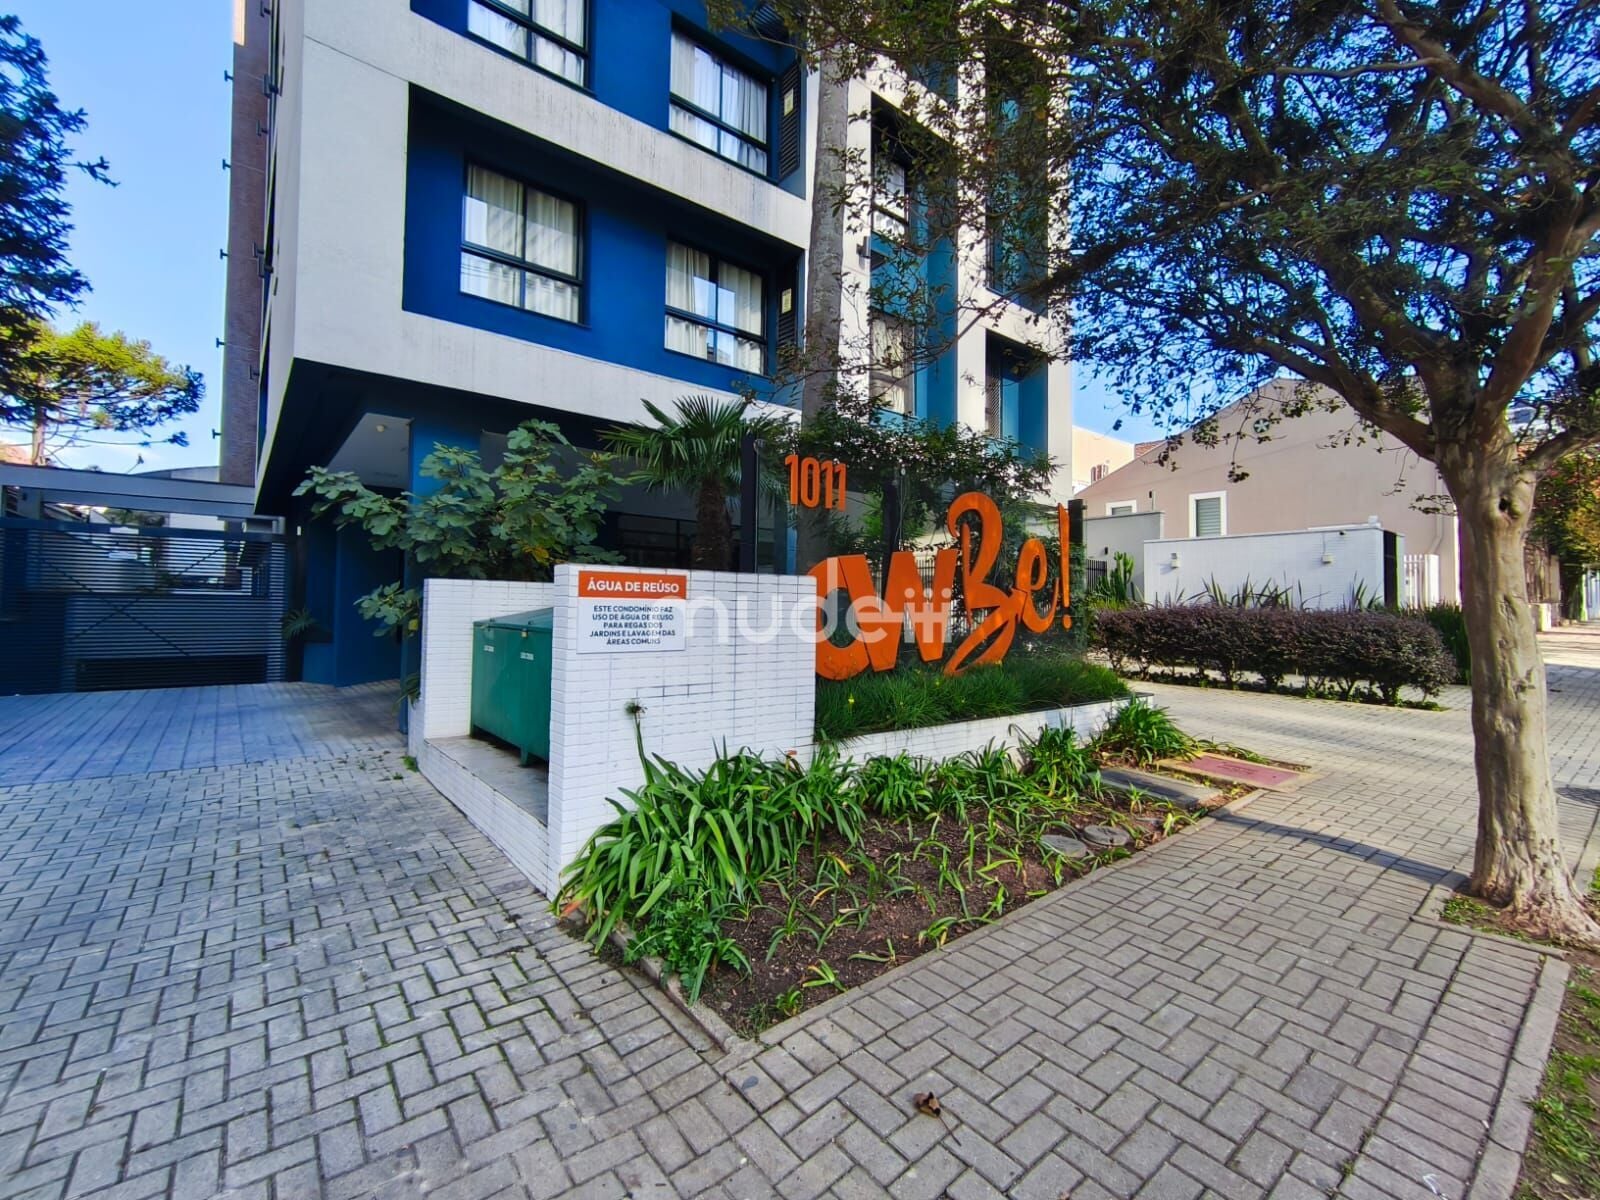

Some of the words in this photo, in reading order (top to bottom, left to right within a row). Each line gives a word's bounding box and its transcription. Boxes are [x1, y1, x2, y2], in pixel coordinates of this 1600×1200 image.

[785, 453, 847, 512] 1011
[587, 577, 622, 591] ÁGUA
[625, 582, 641, 592] DE
[643, 580, 679, 593] REÚSO
[620, 612, 640, 620] ÁGUA
